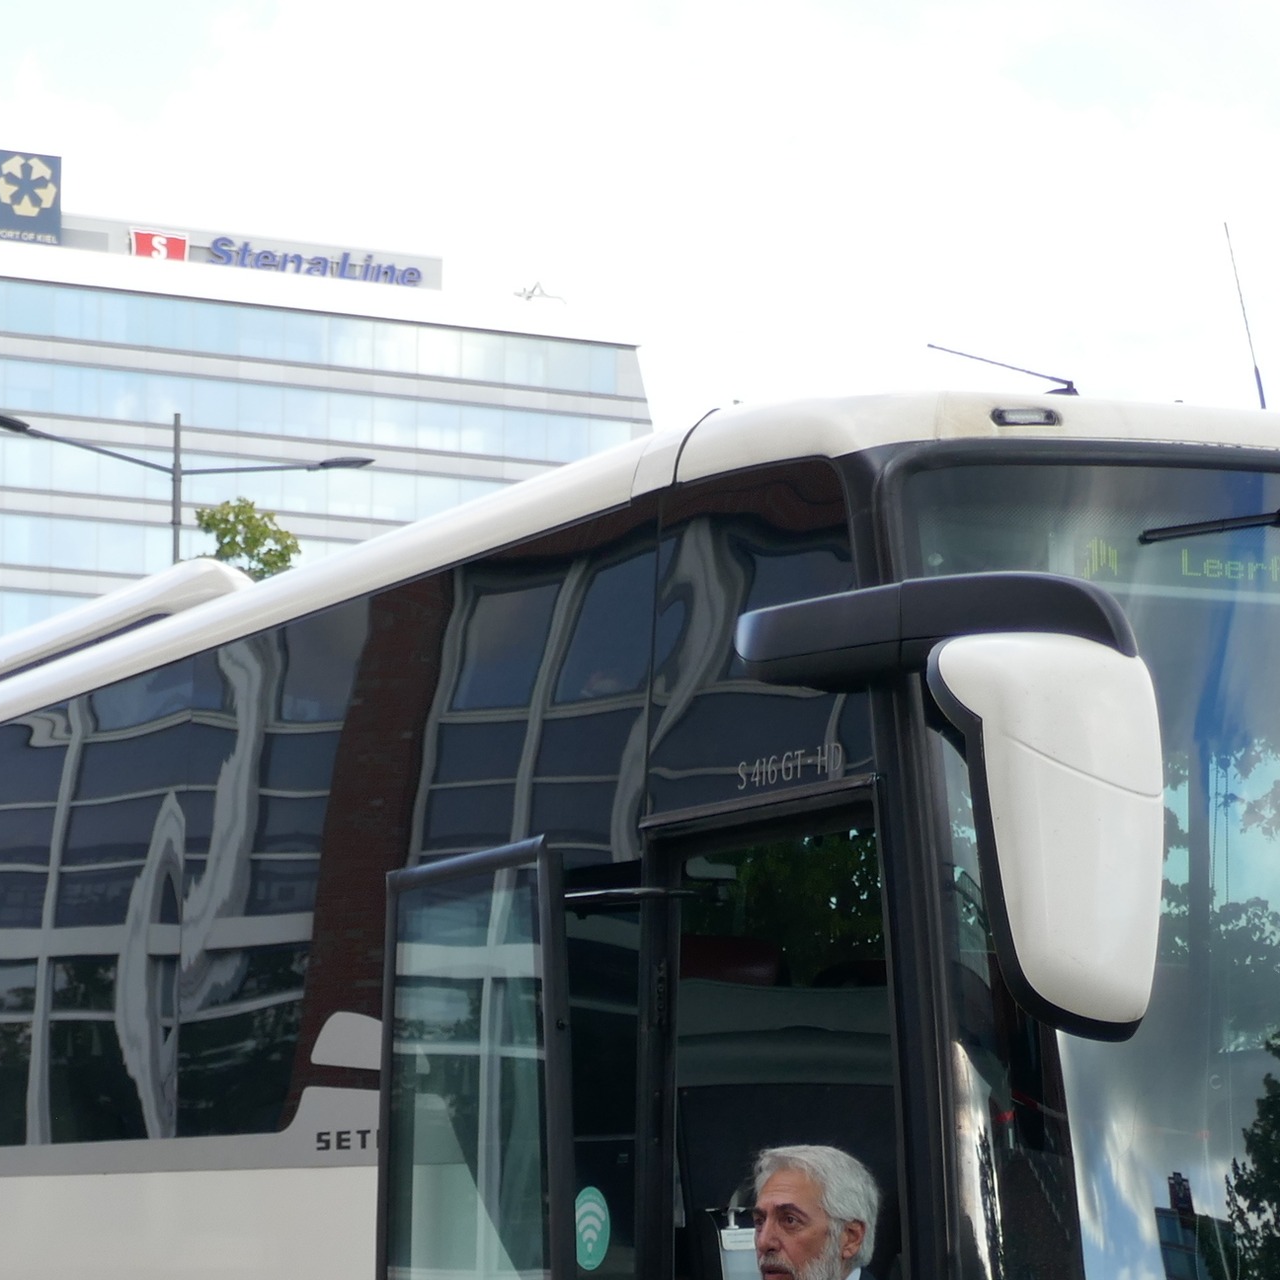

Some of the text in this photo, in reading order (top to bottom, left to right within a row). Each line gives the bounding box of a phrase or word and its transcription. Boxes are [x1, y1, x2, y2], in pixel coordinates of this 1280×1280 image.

[21, 232, 35, 241] OF
[36, 234, 58, 244] KIEL
[316, 1129, 380, 1151] SET
